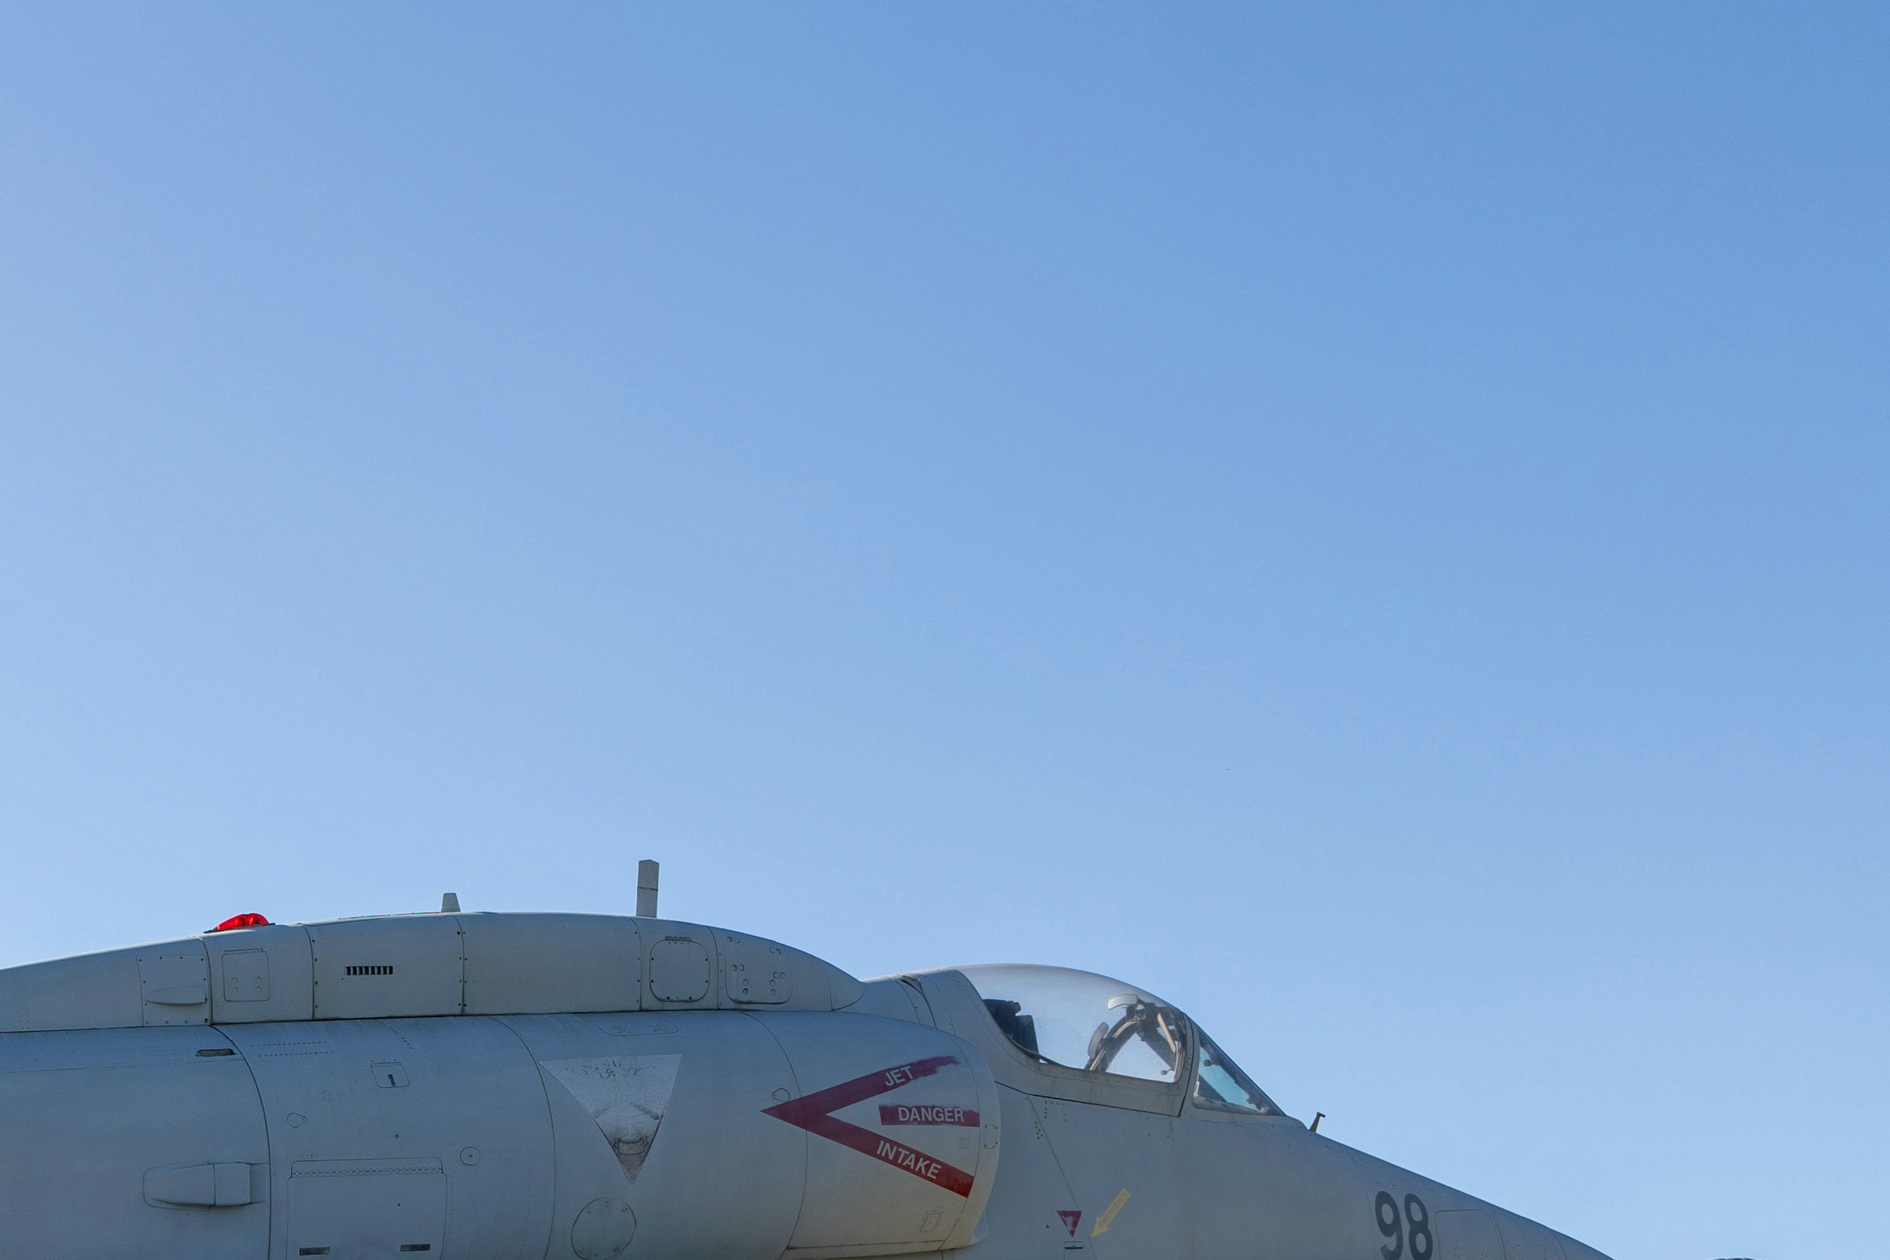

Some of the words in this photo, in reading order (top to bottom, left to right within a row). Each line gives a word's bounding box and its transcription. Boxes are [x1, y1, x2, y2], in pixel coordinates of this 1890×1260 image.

[883, 1063, 914, 1088] JET
[897, 1106, 964, 1123] DANGER
[876, 1139, 941, 1182] INTAKE
